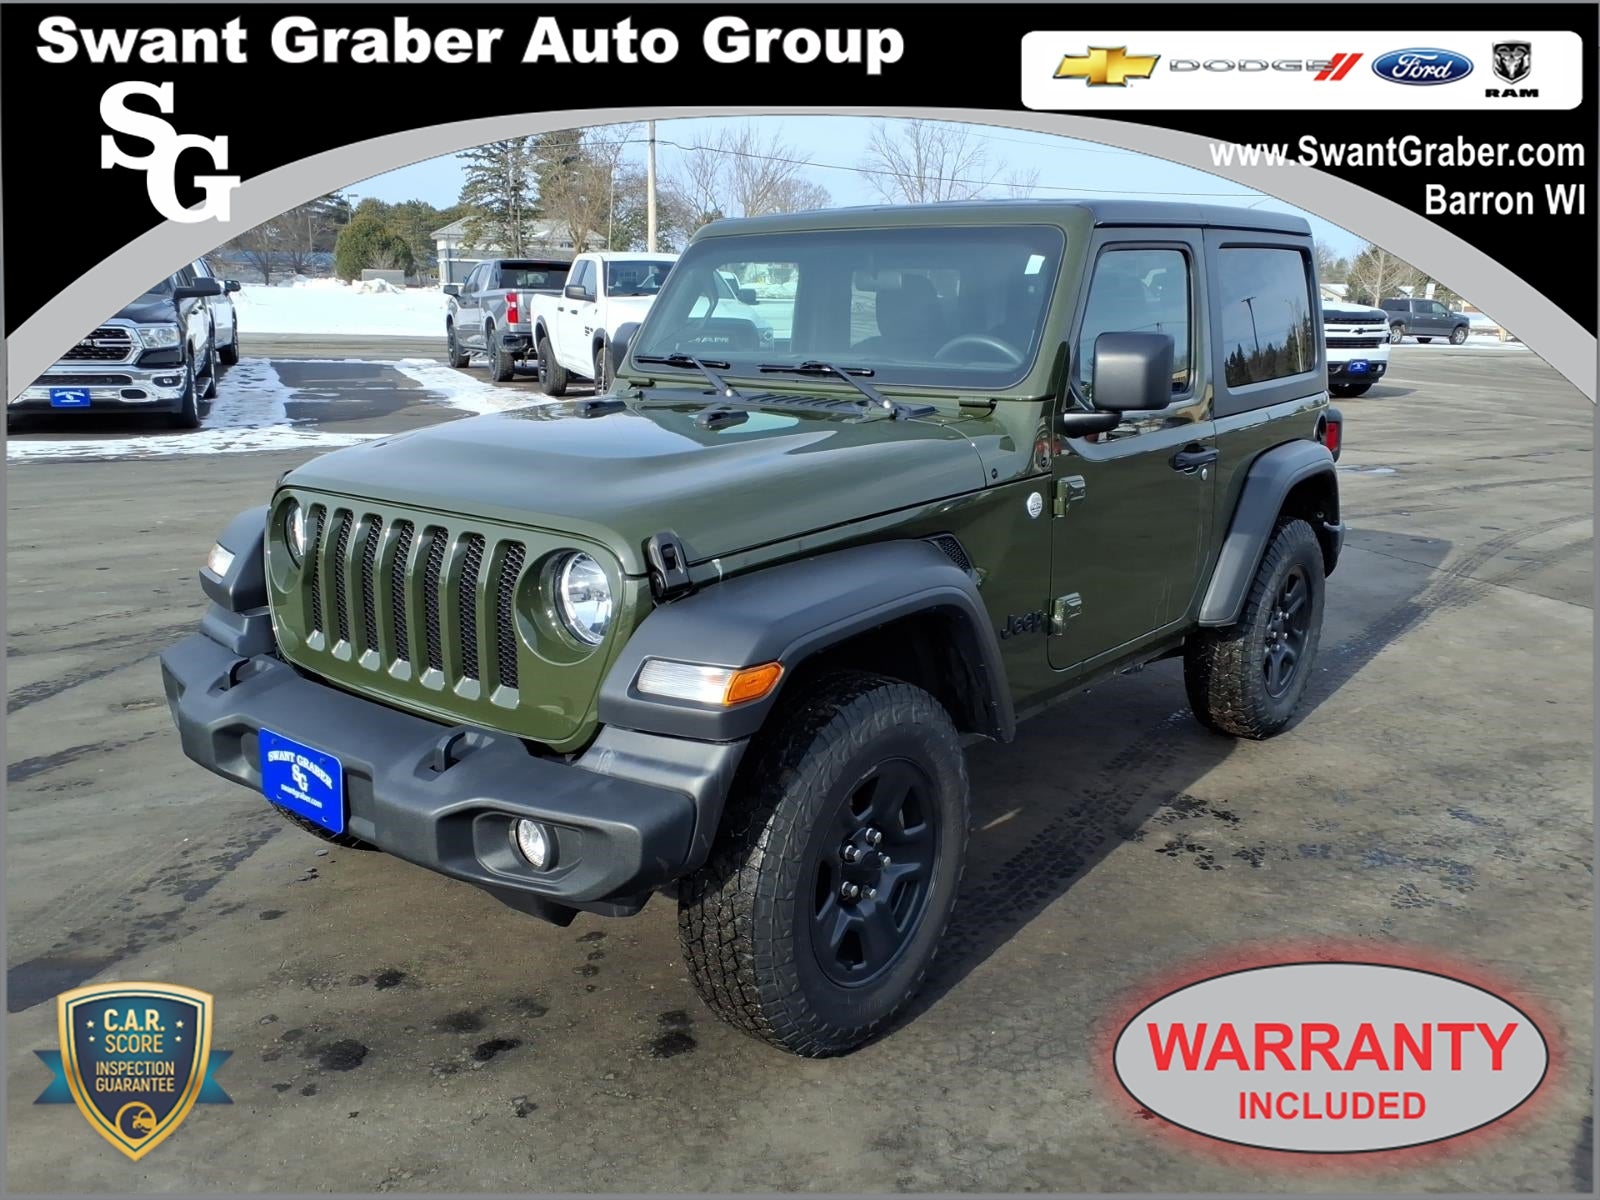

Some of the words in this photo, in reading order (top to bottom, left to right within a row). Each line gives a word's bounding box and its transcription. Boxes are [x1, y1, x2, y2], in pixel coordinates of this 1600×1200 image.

[1000, 611, 1042, 640] Jeep
[268, 750, 296, 763] SWANT
[296, 754, 333, 790] GRABER
[292, 763, 308, 792] SG
